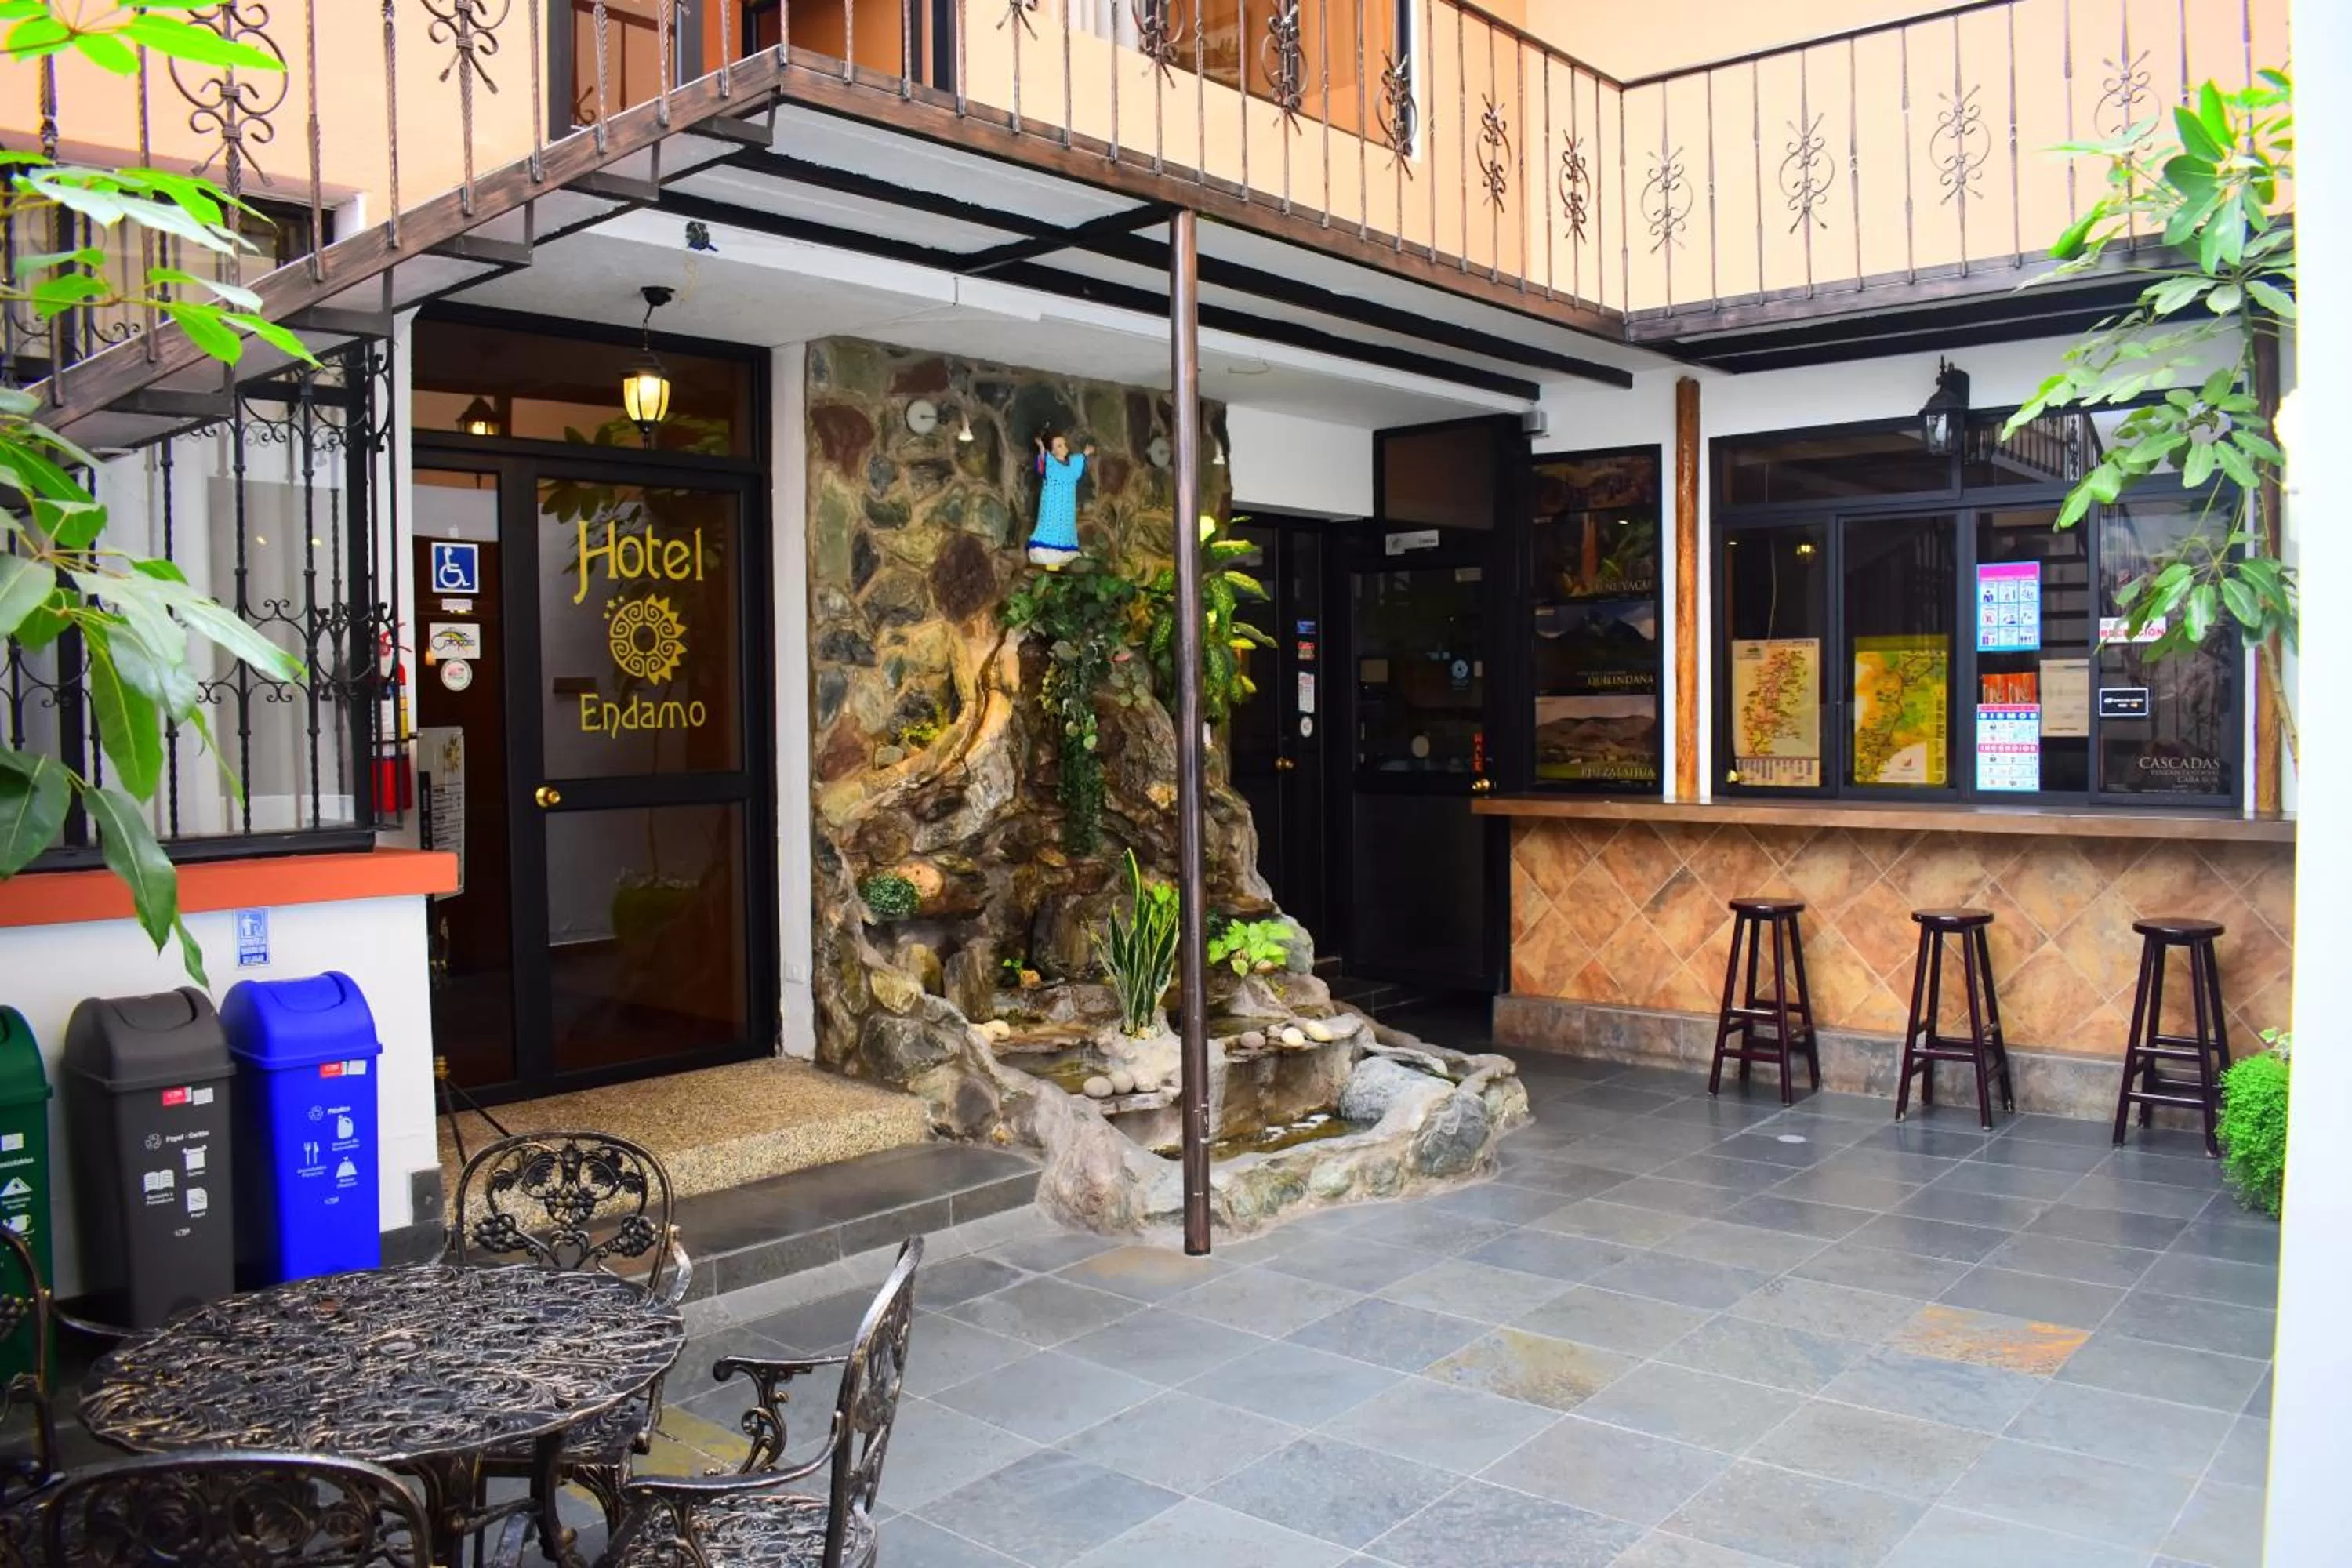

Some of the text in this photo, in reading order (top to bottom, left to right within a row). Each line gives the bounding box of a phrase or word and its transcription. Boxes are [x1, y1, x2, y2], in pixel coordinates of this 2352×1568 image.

[572, 520, 704, 605] Hotel
[579, 693, 706, 739] Endamo
[2139, 756, 2220, 769] CASCADAS
